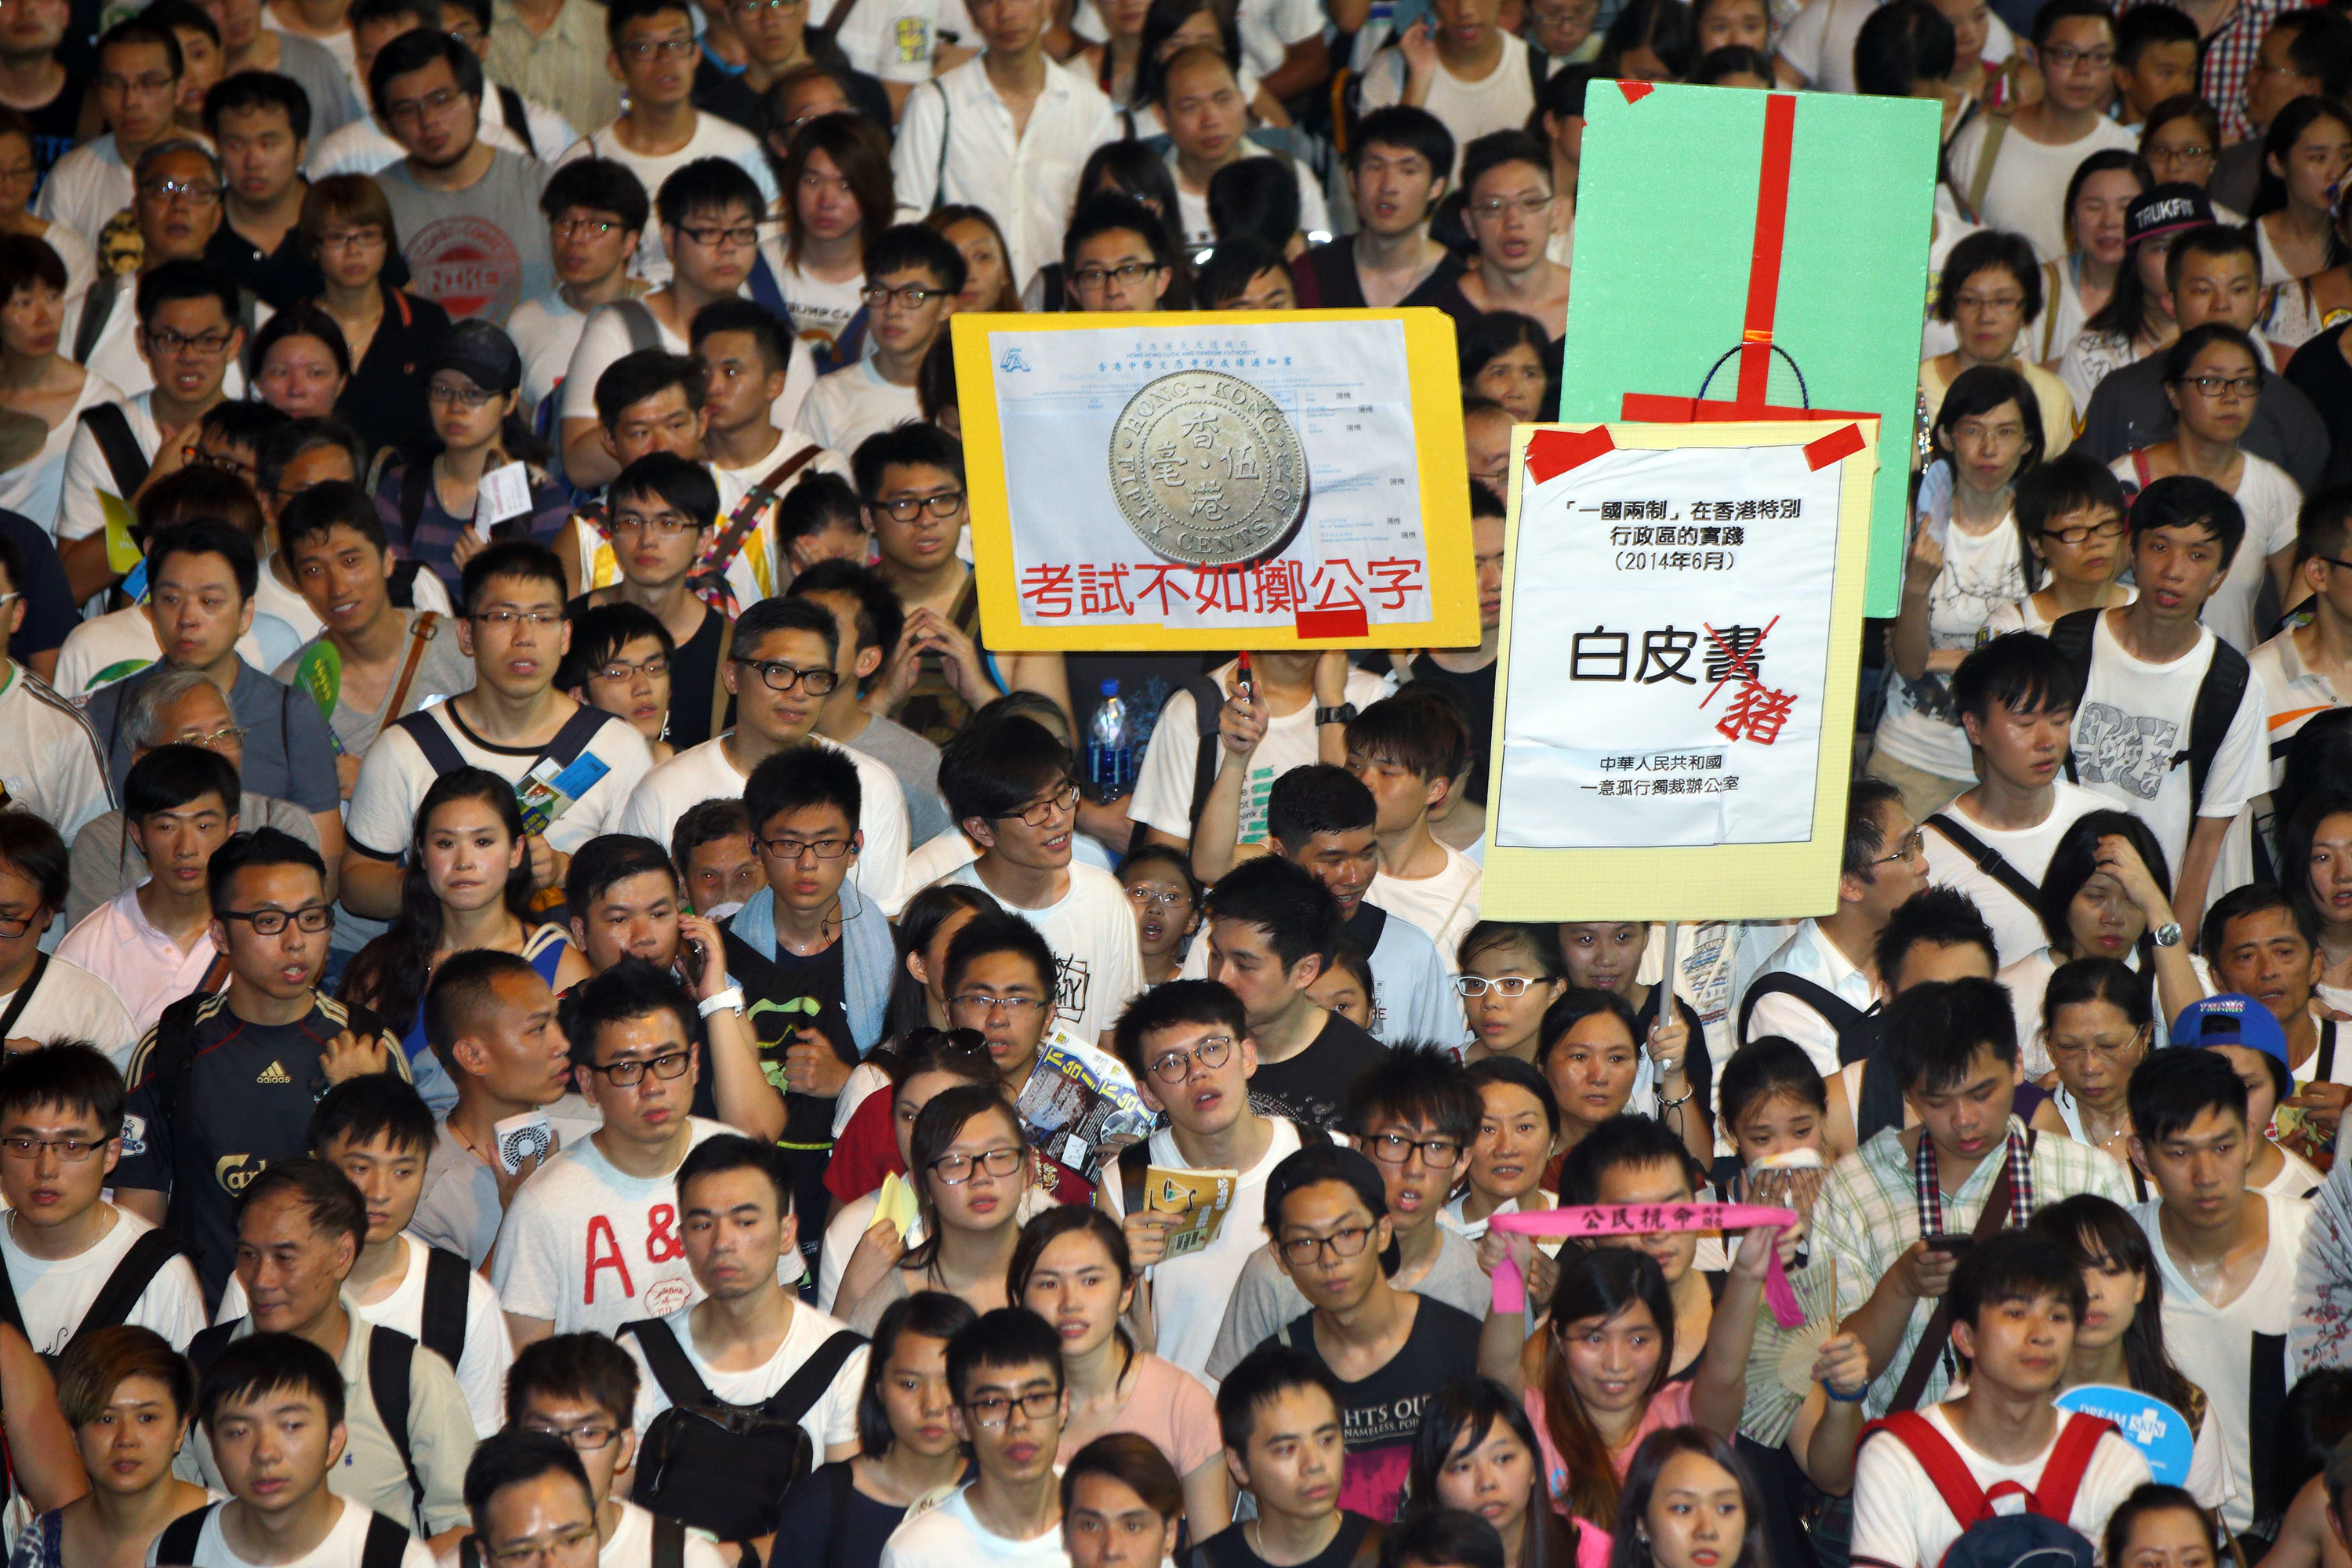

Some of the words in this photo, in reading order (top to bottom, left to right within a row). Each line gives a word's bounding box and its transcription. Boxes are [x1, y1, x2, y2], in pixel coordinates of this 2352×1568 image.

[1566, 499, 1802, 521] 「一國兩制」在香港特別
[1176, 517, 1272, 555] CENTS
[1610, 525, 1744, 546] 行政區的實踐
[1021, 556, 1424, 619] 考試不如擲公字
[1600, 754, 1722, 771] 中華人民共和國
[1581, 775, 1740, 797] 一意孤行獨裁辦公室
[256, 1075, 292, 1083] adidas
[1581, 1207, 1696, 1230] 公民抗命
[583, 1215, 635, 1305] A
[2078, 1403, 2128, 1428] DREAM
[2130, 1418, 2164, 1436] SKIN
